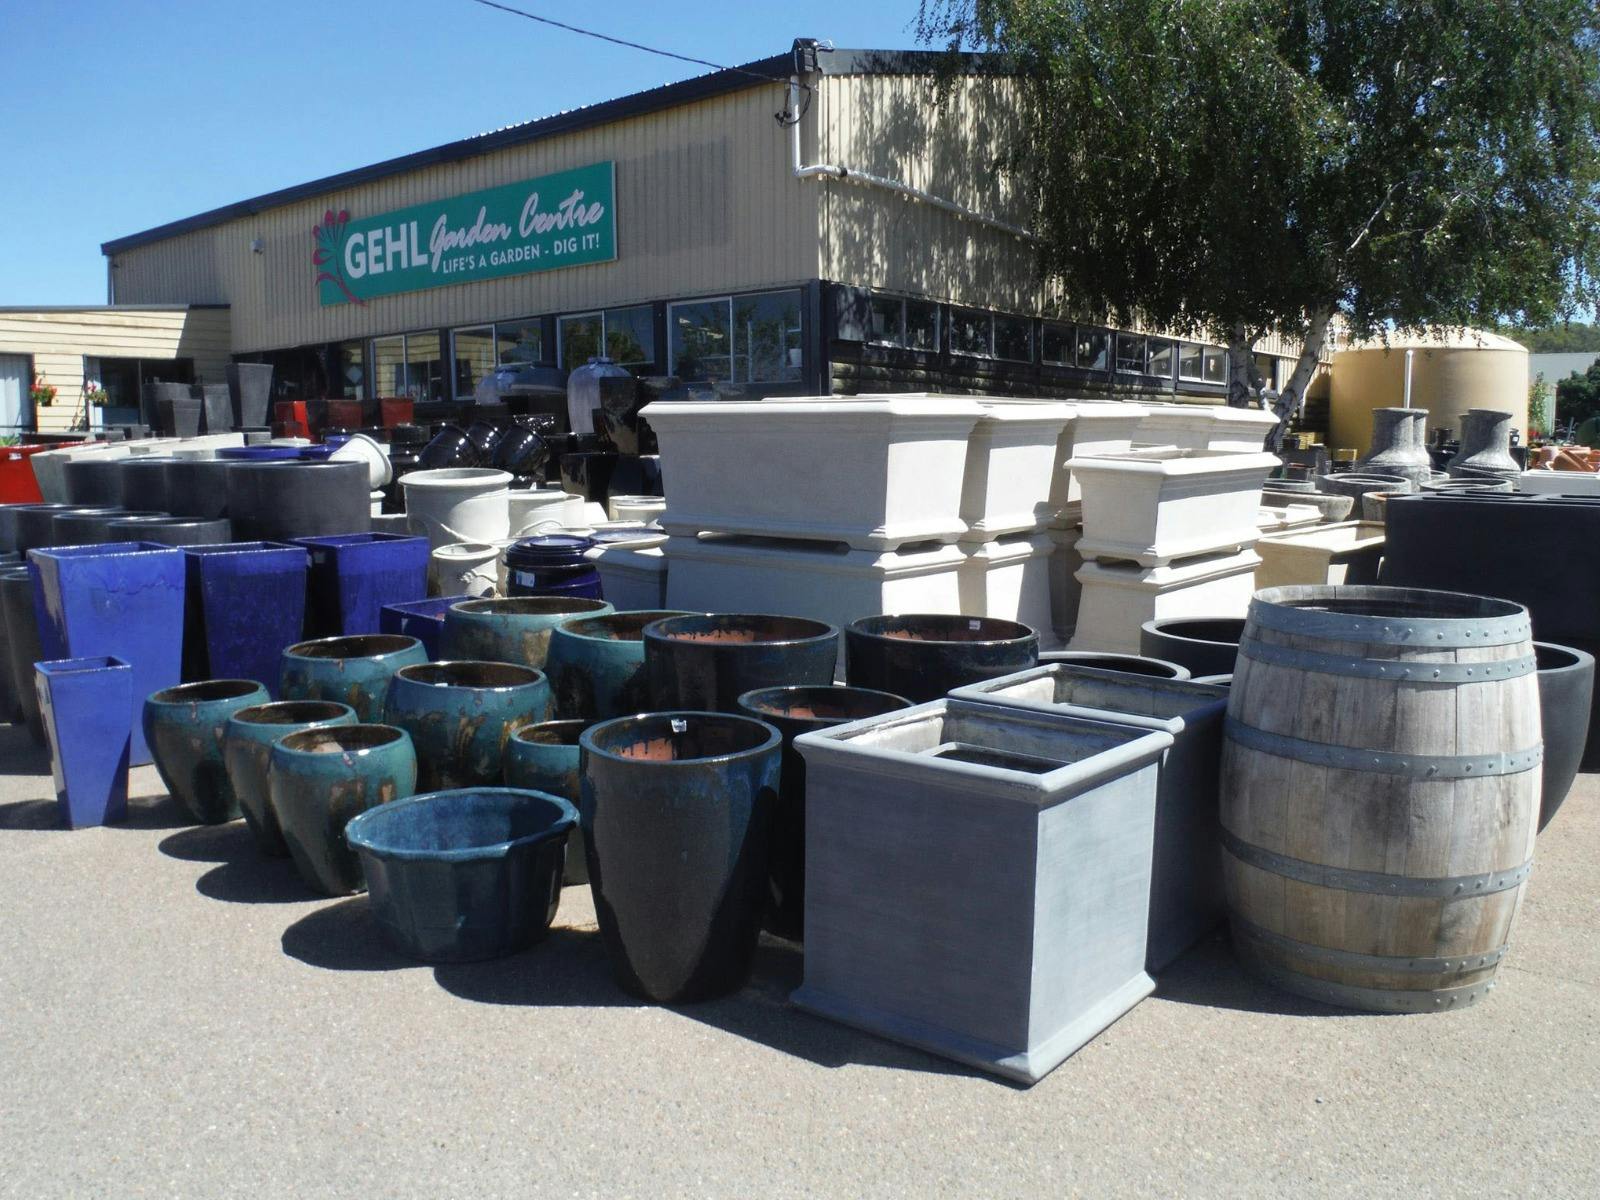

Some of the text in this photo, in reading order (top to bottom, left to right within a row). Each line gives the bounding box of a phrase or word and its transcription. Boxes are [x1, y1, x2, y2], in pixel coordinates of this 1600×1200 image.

[344, 189, 604, 279] GEHL Garden Centre
[442, 254, 475, 274] LIFE'S
[478, 257, 487, 268] A
[490, 245, 541, 266] GARDEN
[554, 238, 578, 256] DIG
[582, 233, 600, 249] IT!
